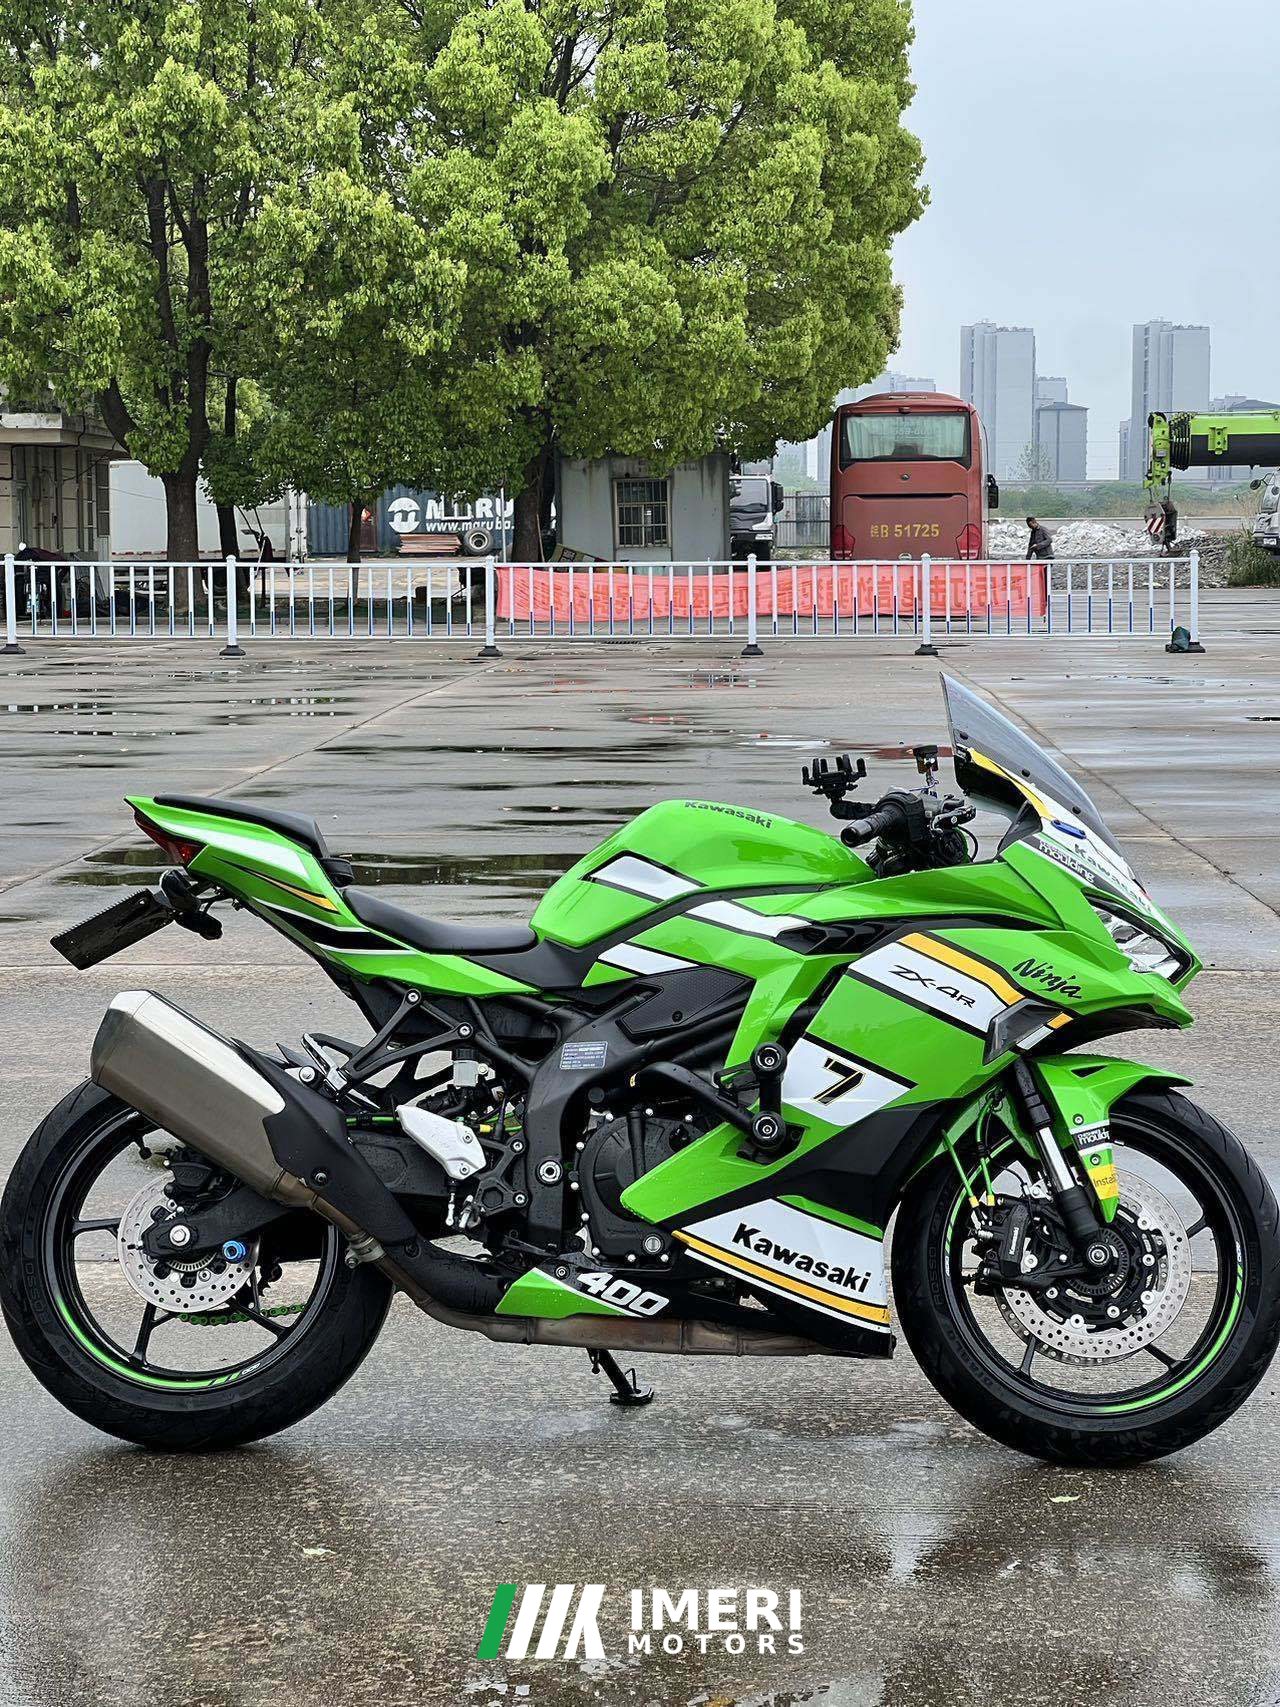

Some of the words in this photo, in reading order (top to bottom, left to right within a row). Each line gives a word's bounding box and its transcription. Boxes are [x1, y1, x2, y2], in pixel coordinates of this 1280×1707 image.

[426, 516, 515, 533] www.maruba.
[894, 523, 940, 538] 51725
[684, 801, 773, 829] Kawasaki
[1040, 844, 1095, 884] moulding
[888, 964, 976, 1008] ZX-4R
[1012, 958, 1082, 1000] Ninja
[811, 1056, 866, 1106] 7
[1093, 1174, 1117, 1187] Insta
[732, 1222, 872, 1294] Kawasaki
[577, 1272, 670, 1316] 400
